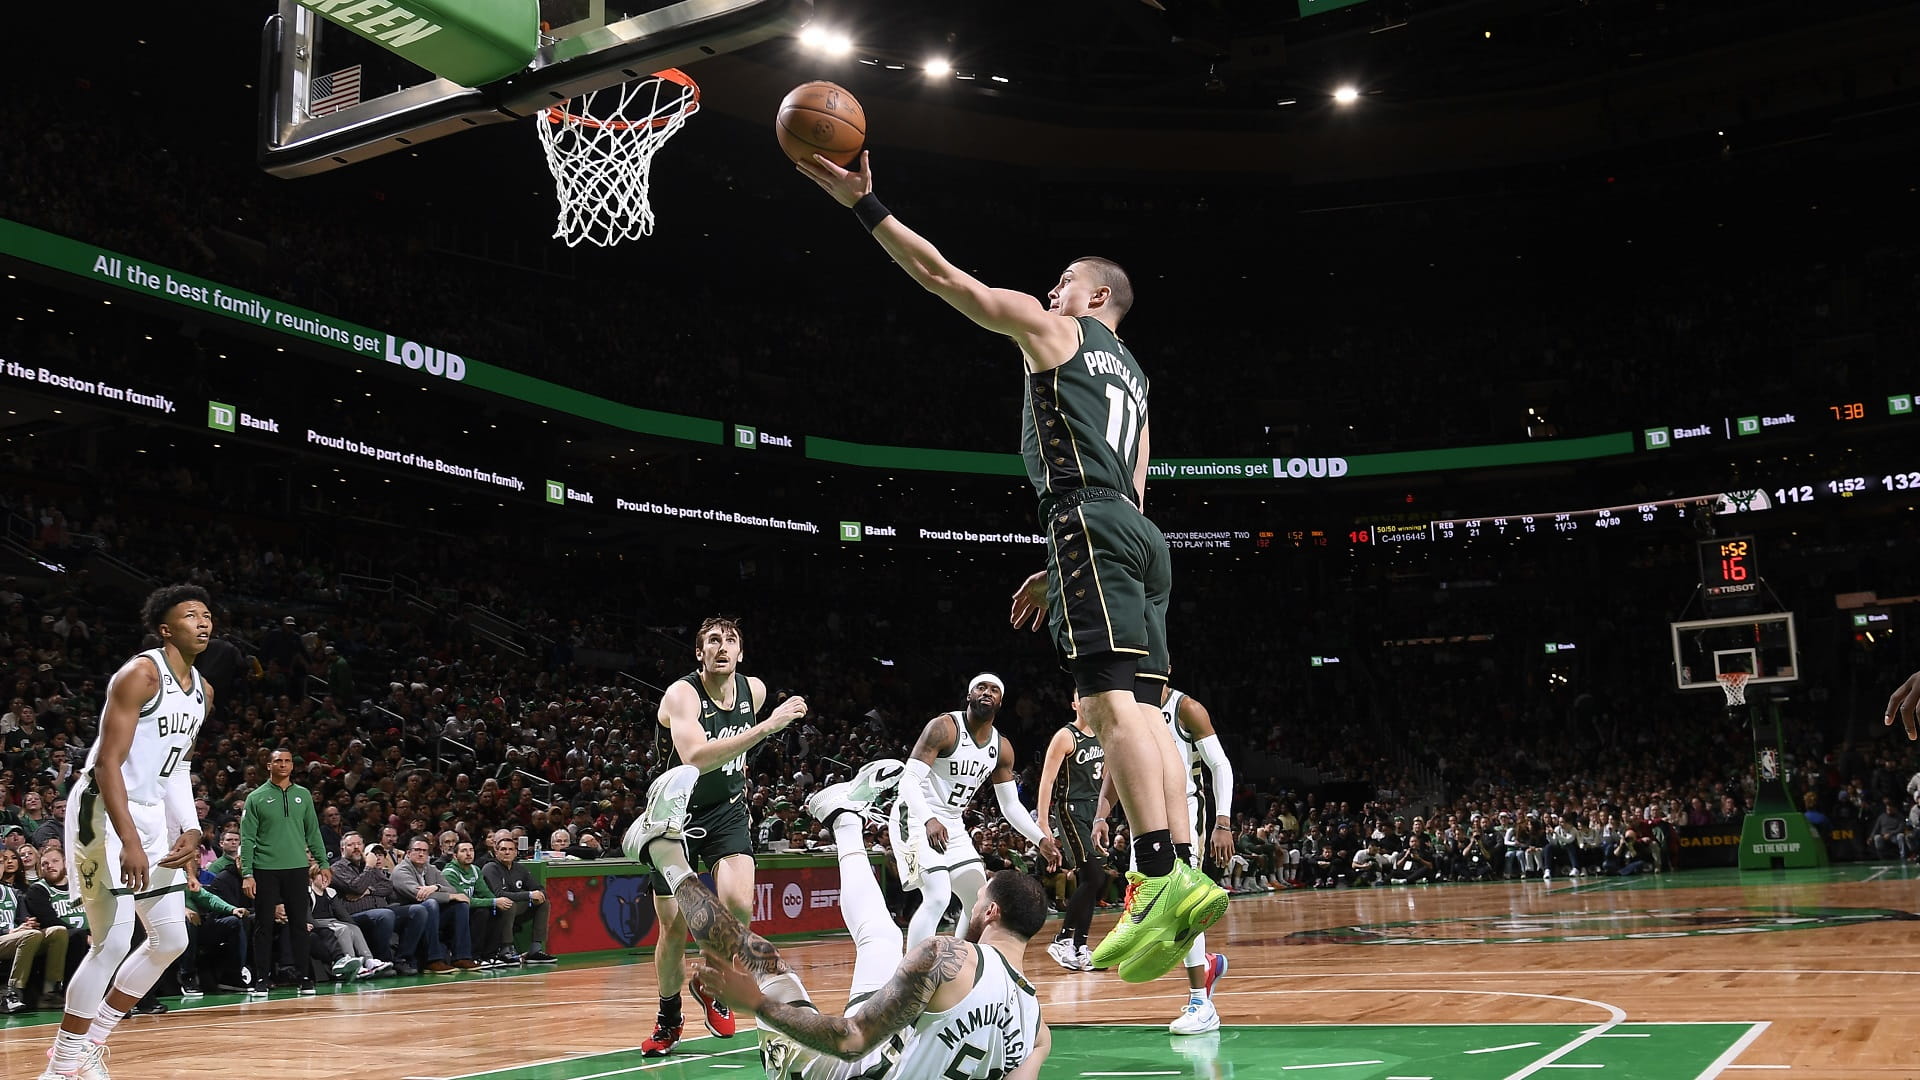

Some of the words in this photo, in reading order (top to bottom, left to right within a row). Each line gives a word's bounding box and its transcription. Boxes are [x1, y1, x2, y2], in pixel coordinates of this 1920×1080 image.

[93, 254, 121, 279] All
[126, 265, 161, 290] the
[165, 274, 209, 304] best
[213, 290, 271, 324] family
[275, 311, 350, 344] reunions
[352, 334, 380, 352] get
[385, 334, 465, 381] LOUD
[6, 362, 36, 380] the
[38, 368, 95, 394] Boston
[97, 381, 124, 400] fan
[125, 388, 176, 413] family.
[240, 413, 279, 433] Bank
[1105, 382, 1138, 466] 11
[1762, 414, 1795, 427] Bank
[760, 432, 793, 448] Bank
[1674, 425, 1711, 439] Bank
[307, 429, 345, 450] Proud
[345, 440, 359, 453] to
[359, 442, 376, 457] be
[376, 449, 401, 464] part
[402, 454, 416, 465] of
[415, 456, 435, 471] the
[435, 460, 473, 479] Boston
[473, 469, 492, 483] fan
[491, 474, 526, 491] family.
[1147, 462, 1177, 477] mily
[1180, 462, 1241, 475] reunions
[1244, 465, 1268, 477] get
[1272, 457, 1348, 478] LOUD
[1828, 477, 1866, 493] 1:52
[1881, 471, 1920, 491] 132
[567, 488, 594, 504] Bank
[1775, 485, 1815, 504] 112
[616, 498, 650, 513] Proud
[650, 504, 663, 514] to
[663, 504, 679, 516] be
[679, 507, 703, 519] part
[703, 510, 716, 520] of
[715, 511, 734, 523] the
[733, 512, 770, 527] Boston
[770, 517, 788, 529] fan
[787, 519, 822, 534] family.
[1438, 521, 1455, 530] REB
[1465, 520, 1481, 528] AST
[1494, 518, 1509, 526] STL
[1521, 516, 1535, 524] TO
[1598, 510, 1611, 518] FG
[1442, 530, 1454, 539] 39
[1469, 528, 1480, 537] 21
[1498, 527, 1505, 535] 7
[1525, 524, 1536, 533] 15
[1642, 512, 1654, 522] 50
[1678, 509, 1685, 518] 2
[864, 526, 897, 537] Bank
[919, 529, 952, 541] Proud
[952, 531, 965, 541] to
[965, 531, 979, 542] be
[979, 533, 1002, 544] part
[1001, 534, 1015, 543] of
[1014, 534, 1033, 544] the
[1232, 530, 1250, 540] TWO
[1348, 530, 1370, 544] 16
[1171, 540, 1184, 549] TO
[1184, 540, 1204, 549] PLAY
[1204, 540, 1214, 548] IN
[1213, 540, 1231, 549] THE
[1720, 541, 1747, 557] 1:52
[1722, 556, 1747, 581] 16
[1719, 583, 1756, 594] TISSOT
[159, 746, 182, 778] 0
[721, 751, 748, 777] 40
[1091, 760, 1105, 780] 3
[1680, 834, 1741, 849] GARDEN
[784, 893, 802, 906] abc
[810, 889, 841, 908] ESP
